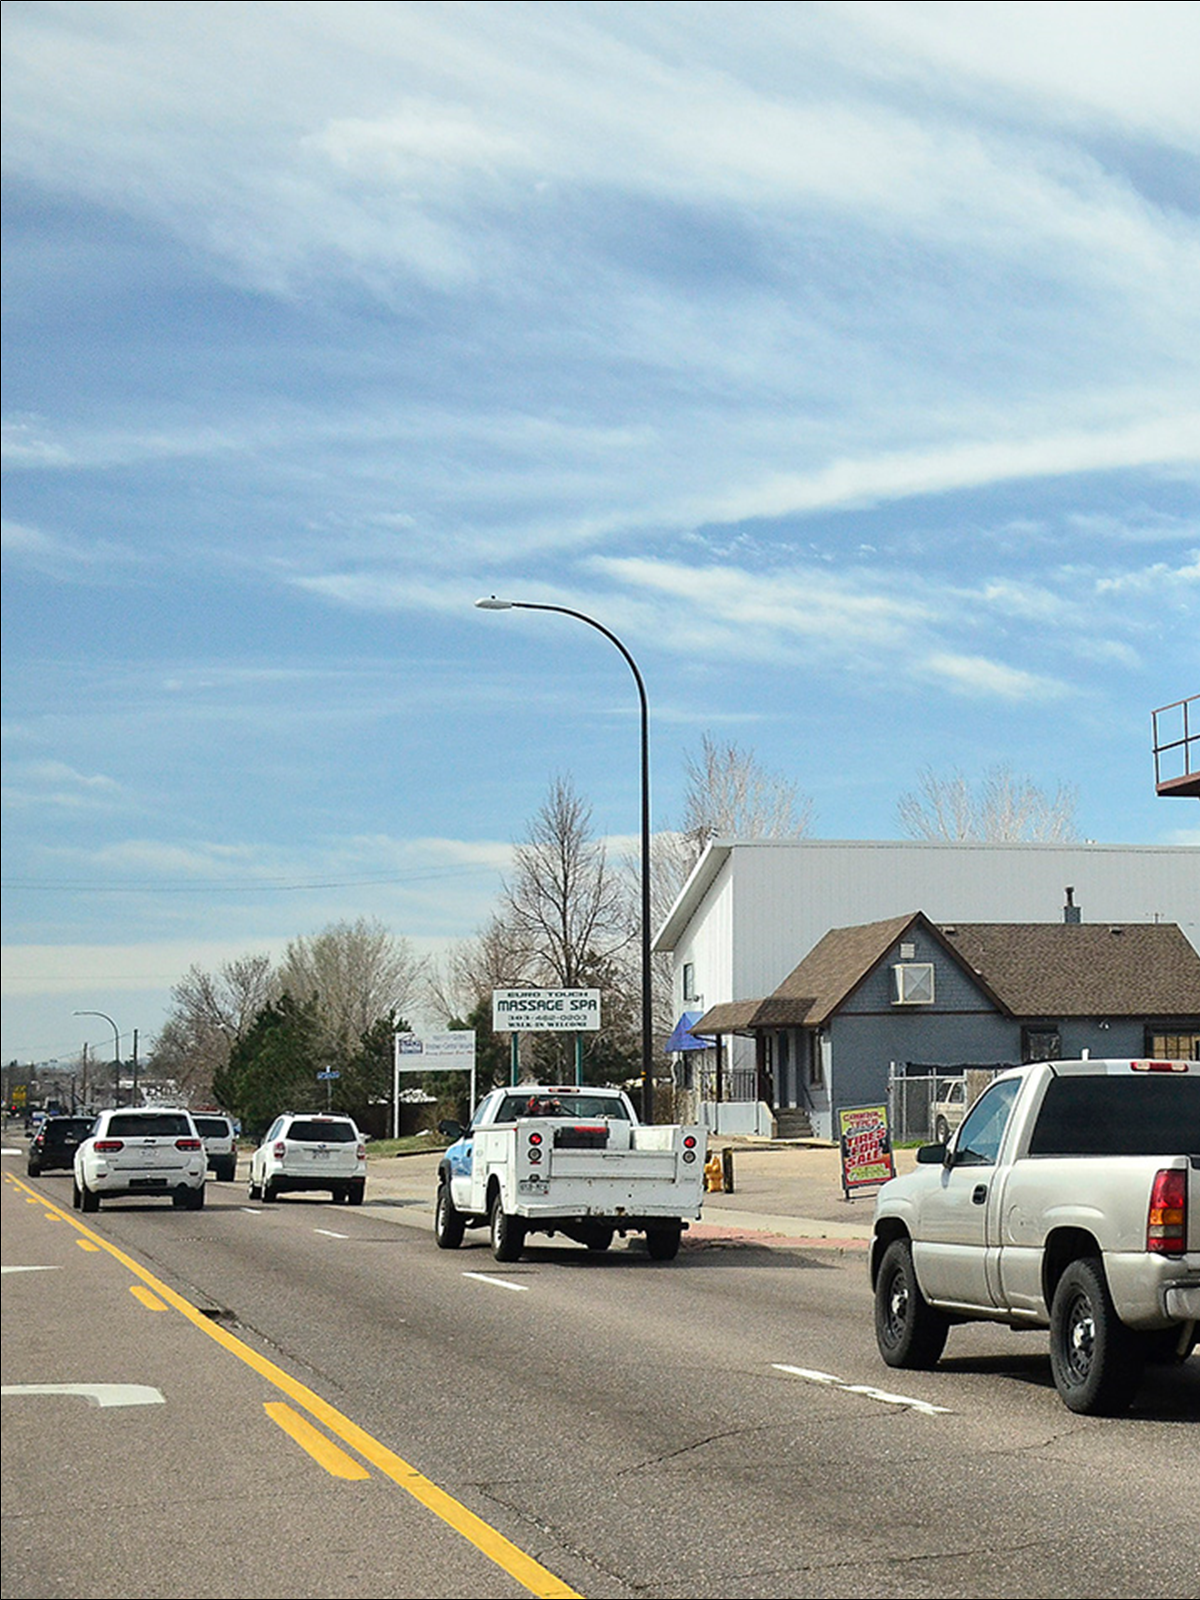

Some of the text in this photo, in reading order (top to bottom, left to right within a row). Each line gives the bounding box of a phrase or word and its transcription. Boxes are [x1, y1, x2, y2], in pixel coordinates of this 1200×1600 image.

[497, 999, 597, 1012] MASSAGE SPA
[846, 1127, 886, 1147] TIRES
[851, 1139, 879, 1155] FOR
[845, 1148, 883, 1168] SALE
